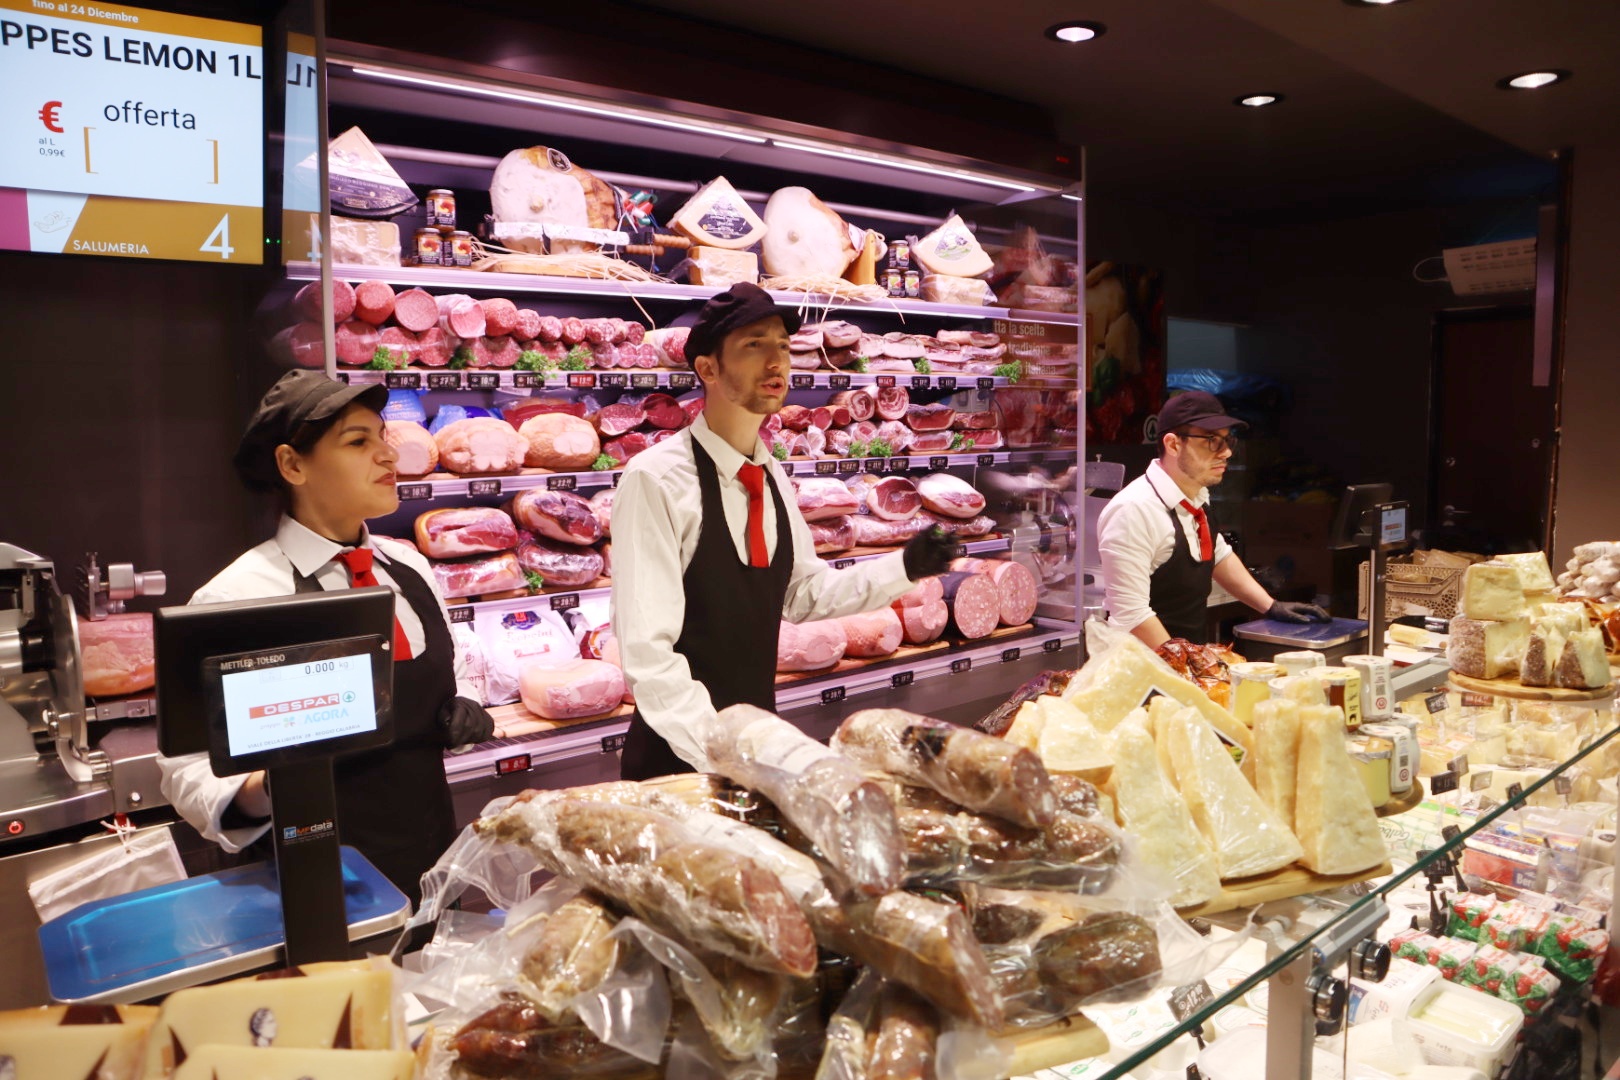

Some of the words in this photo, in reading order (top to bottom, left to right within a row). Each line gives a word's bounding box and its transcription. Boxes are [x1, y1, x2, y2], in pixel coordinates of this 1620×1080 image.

[33, 0, 55, 10] fino
[58, 3, 69, 12] al
[71, 5, 86, 15] 24
[88, 7, 140, 23] Dicembre
[0, 19, 93, 58] PPES
[104, 36, 217, 75] LEMON
[228, 54, 262, 80] 1L
[38, 100, 65, 133] €
[104, 100, 197, 130] offerta
[38, 137, 48, 145] al
[50, 138, 56, 146] L
[73, 239, 149, 255] SALUMERIA
[199, 213, 235, 259] 4
[1019, 324, 1045, 336] scelta
[305, 661, 335, 675] 0.000
[263, 694, 339, 716] DESPAR
